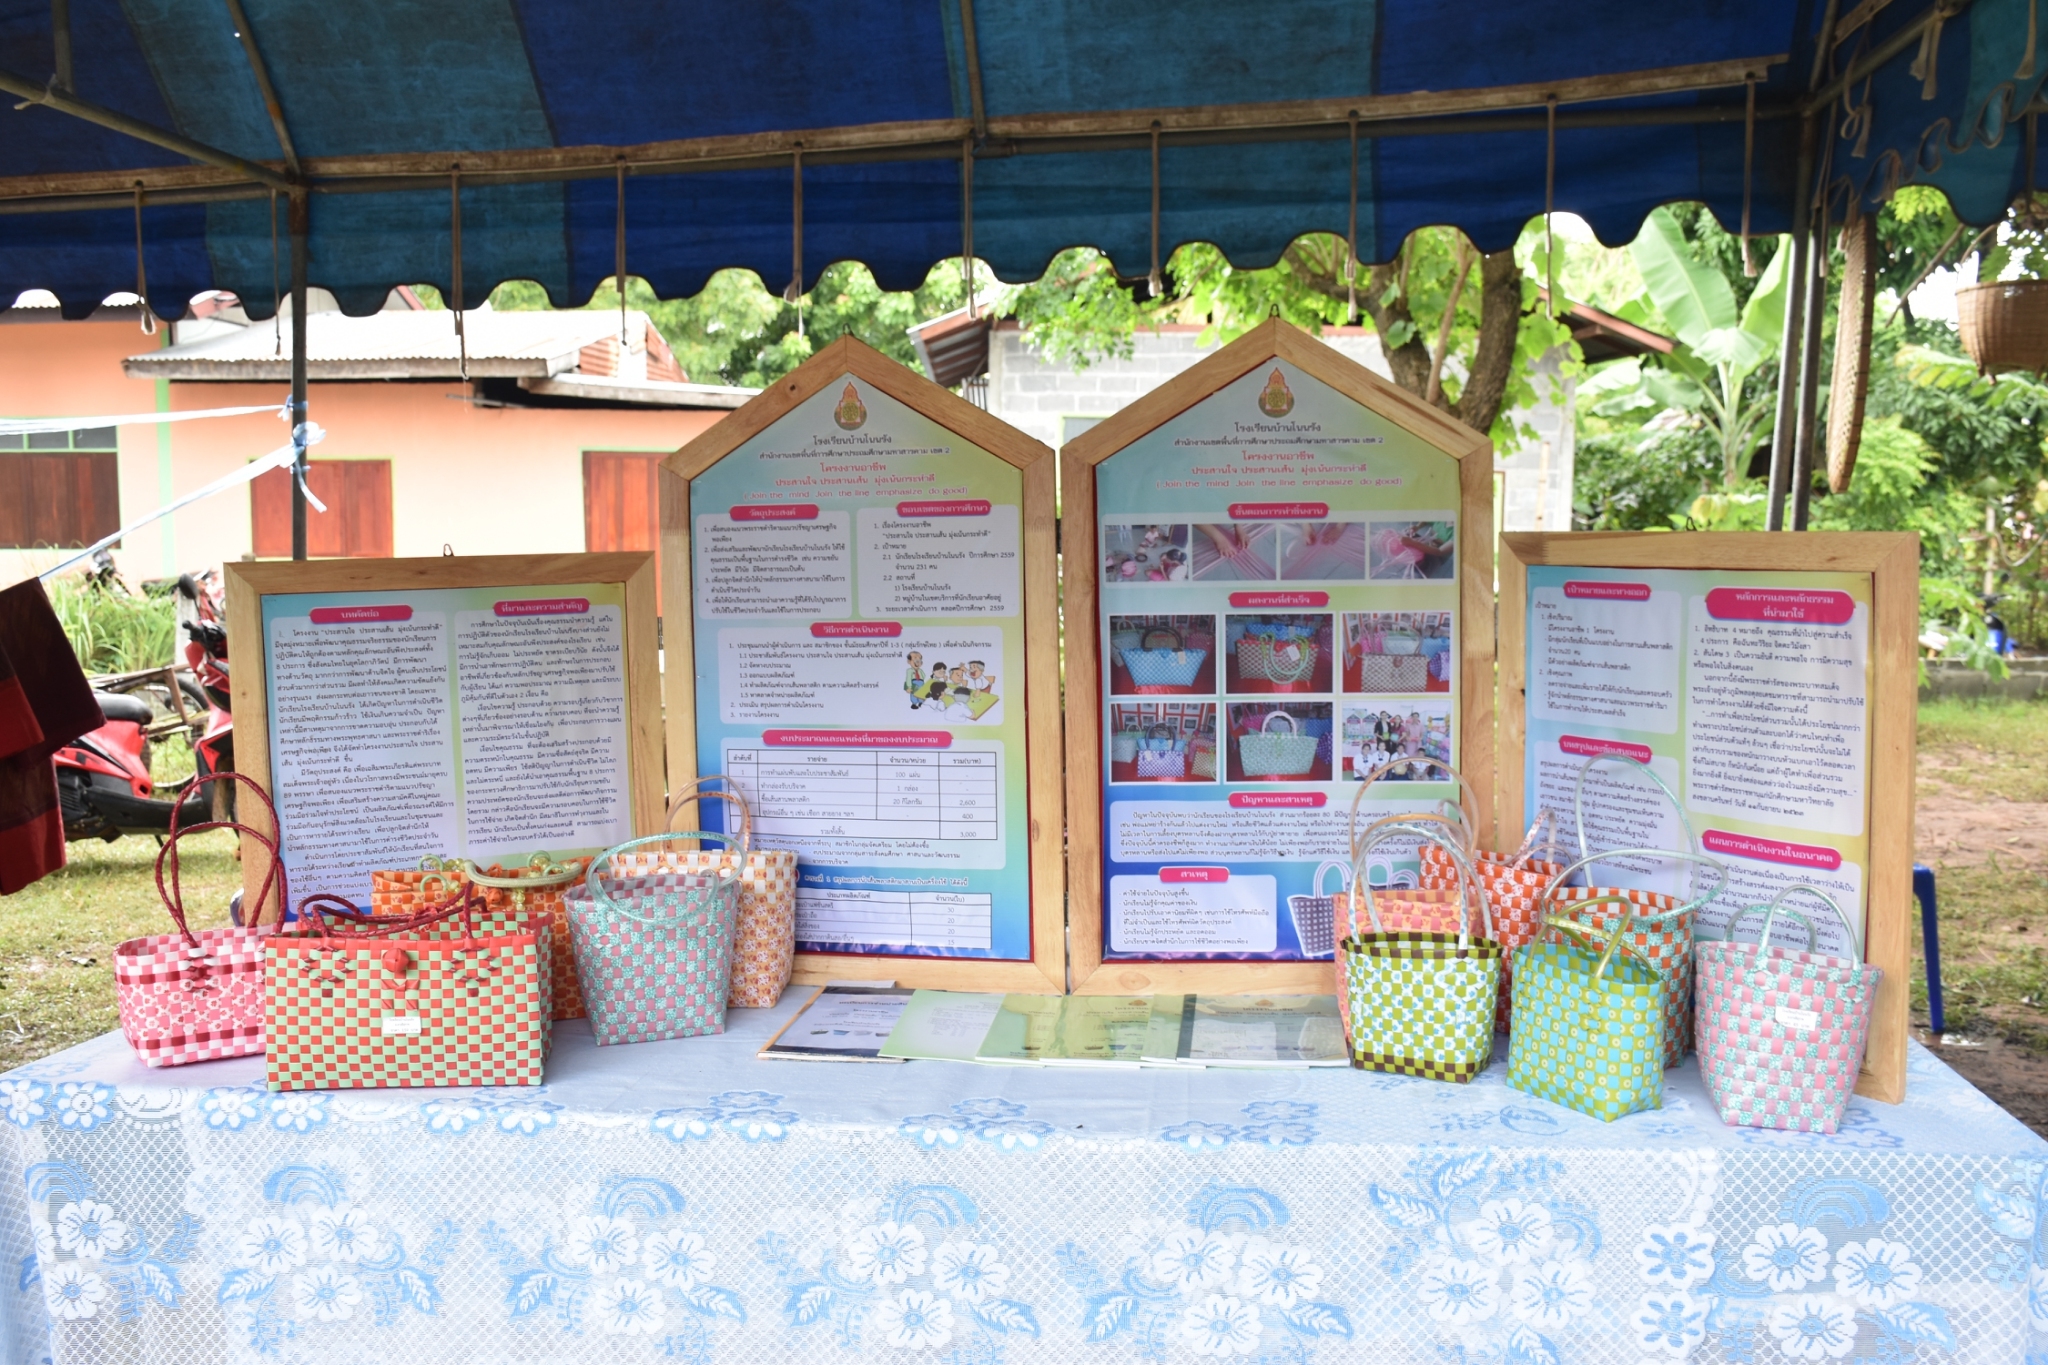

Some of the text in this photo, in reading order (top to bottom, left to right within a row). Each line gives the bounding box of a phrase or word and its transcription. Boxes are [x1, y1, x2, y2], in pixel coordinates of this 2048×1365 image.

[1162, 479, 1183, 488] Join
[1183, 479, 1201, 488] the
[1205, 479, 1230, 488] mind
[1235, 479, 1256, 487] Join
[1260, 478, 1277, 487] the
[1278, 478, 1296, 487] line
[1358, 478, 1372, 486] do
[1373, 476, 1403, 487] good)
[749, 490, 768, 500] Join
[768, 490, 784, 498] the
[788, 490, 810, 498] mind
[815, 490, 833, 498] Join
[837, 489, 852, 497] the
[853, 489, 871, 497] line
[927, 486, 941, 495] do
[940, 485, 968, 496] good)
[1782, 808, 1804, 816] ๒๕๒๓
